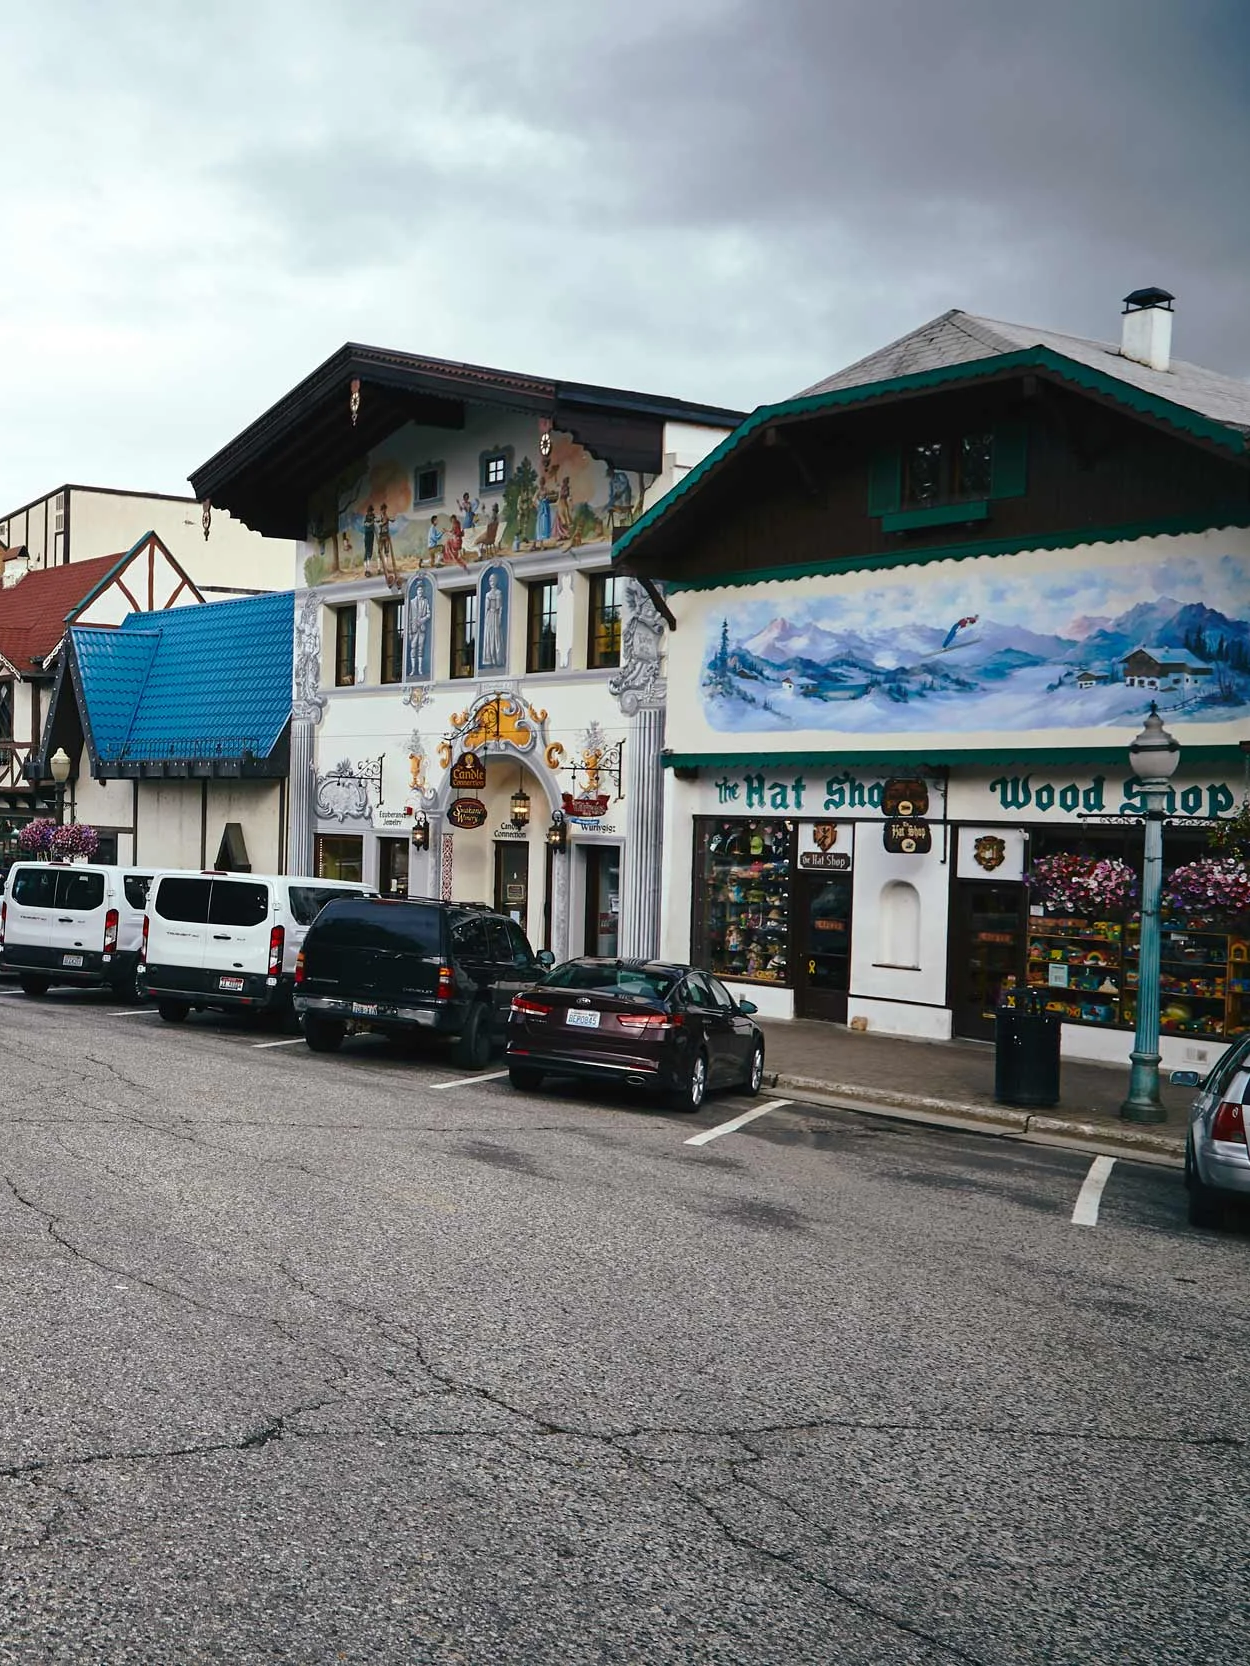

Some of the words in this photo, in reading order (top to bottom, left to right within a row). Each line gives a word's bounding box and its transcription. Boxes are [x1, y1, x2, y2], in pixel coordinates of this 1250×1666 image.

[453, 768, 484, 780] Candle
[743, 772, 806, 811] Hat
[824, 770, 884, 812] Sho
[989, 773, 1107, 813] Wood
[891, 824, 905, 839] Hat
[907, 824, 926, 839] Shop
[812, 854, 825, 866] Hat
[827, 855, 846, 868] Shop
